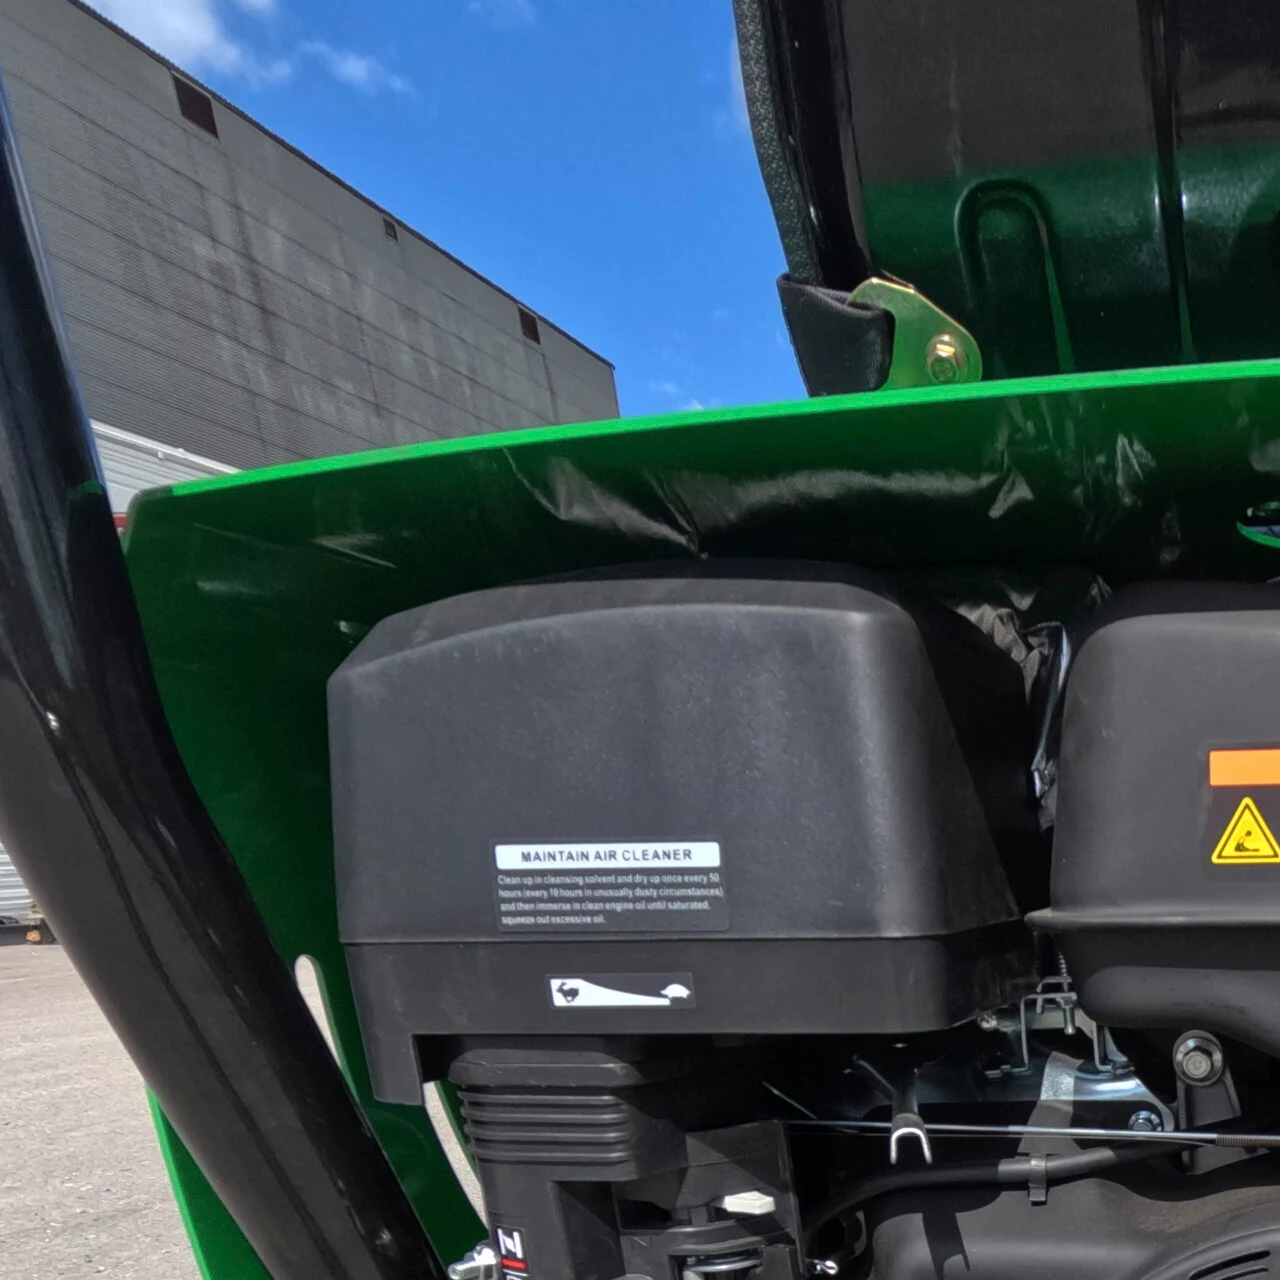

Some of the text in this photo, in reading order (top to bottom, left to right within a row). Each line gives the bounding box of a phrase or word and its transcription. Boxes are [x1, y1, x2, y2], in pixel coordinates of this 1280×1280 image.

[520, 848, 693, 863] MAINTAIN AIR CLEANER
[497, 872, 720, 886] Clean up in cleansing solvent and dry up once every 50
[498, 888, 522, 898] hours
[559, 888, 583, 897] hours
[584, 888, 592, 897] in
[592, 887, 633, 899] unusually
[634, 886, 657, 899] dusty
[658, 886, 724, 898] circumstances)
[500, 902, 516, 912] and
[516, 902, 535, 912] then
[535, 901, 571, 911] immerse
[572, 901, 580, 910] in
[581, 901, 604, 911] clean
[604, 902, 634, 913] engine
[634, 900, 646, 911] oil
[647, 900, 666, 910] until
[535, 915, 550, 924] out
[550, 914, 592, 925] excessive
